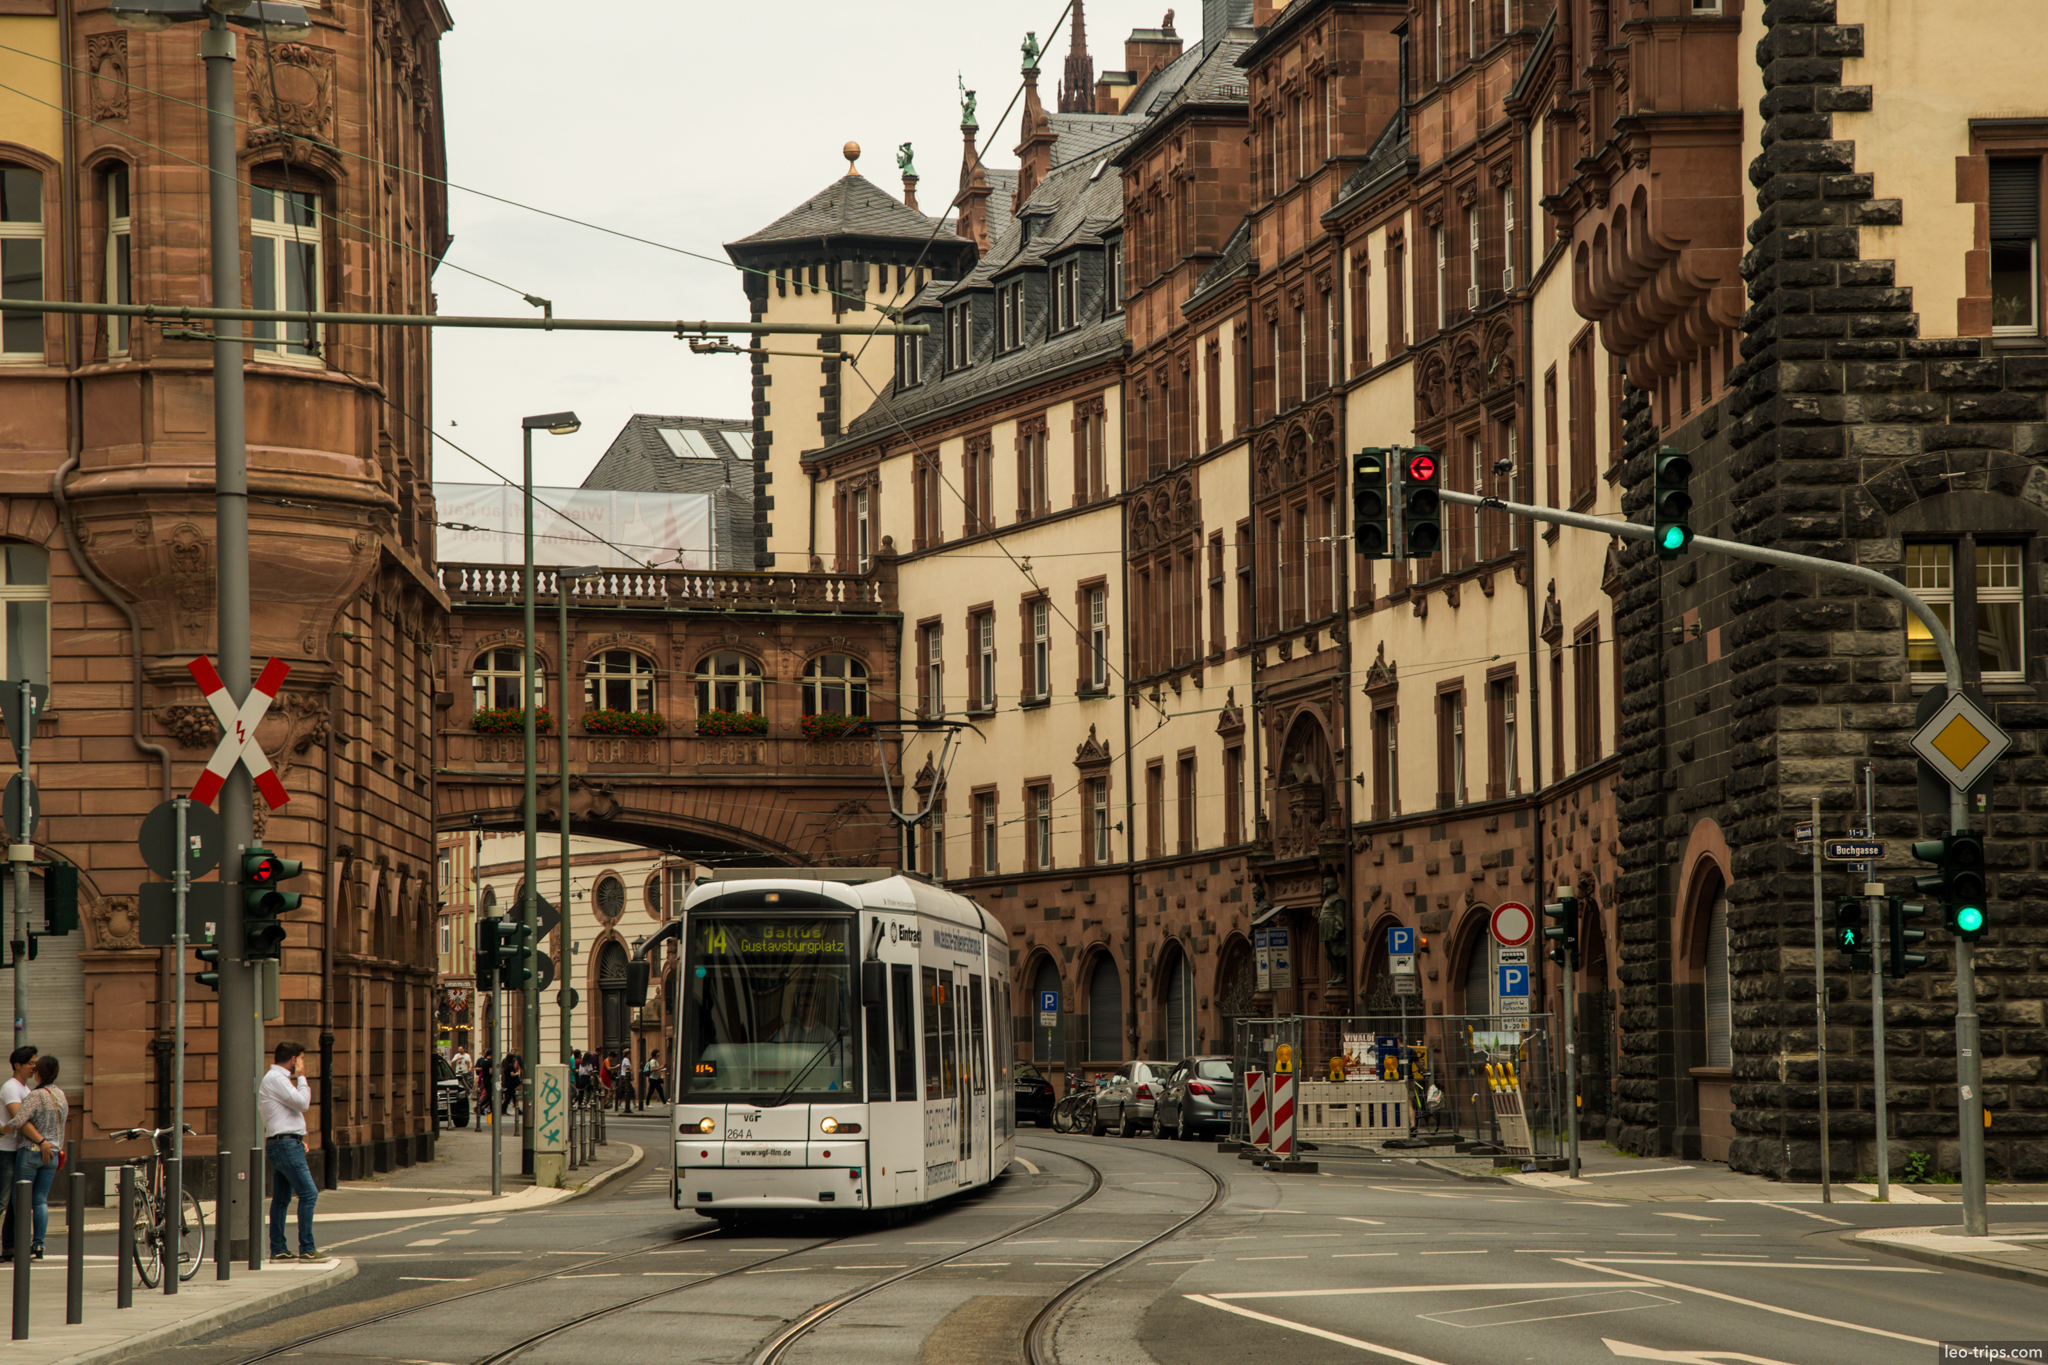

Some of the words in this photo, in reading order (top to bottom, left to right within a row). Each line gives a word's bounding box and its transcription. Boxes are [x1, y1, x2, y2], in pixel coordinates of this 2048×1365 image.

[1836, 845, 1879, 857] Buchgasse
[763, 926, 822, 939] Gallus
[704, 926, 727, 954] 14
[1394, 931, 1408, 951] P
[741, 939, 844, 954] Gustavsburgplatz
[1506, 969, 1522, 993] P
[1344, 1034, 1375, 1042] VIVALDI
[744, 1110, 762, 1122] VGF
[727, 1129, 744, 1139] 264
[745, 1129, 753, 1139] A
[740, 1149, 792, 1158] www.vgf-ffm.de
